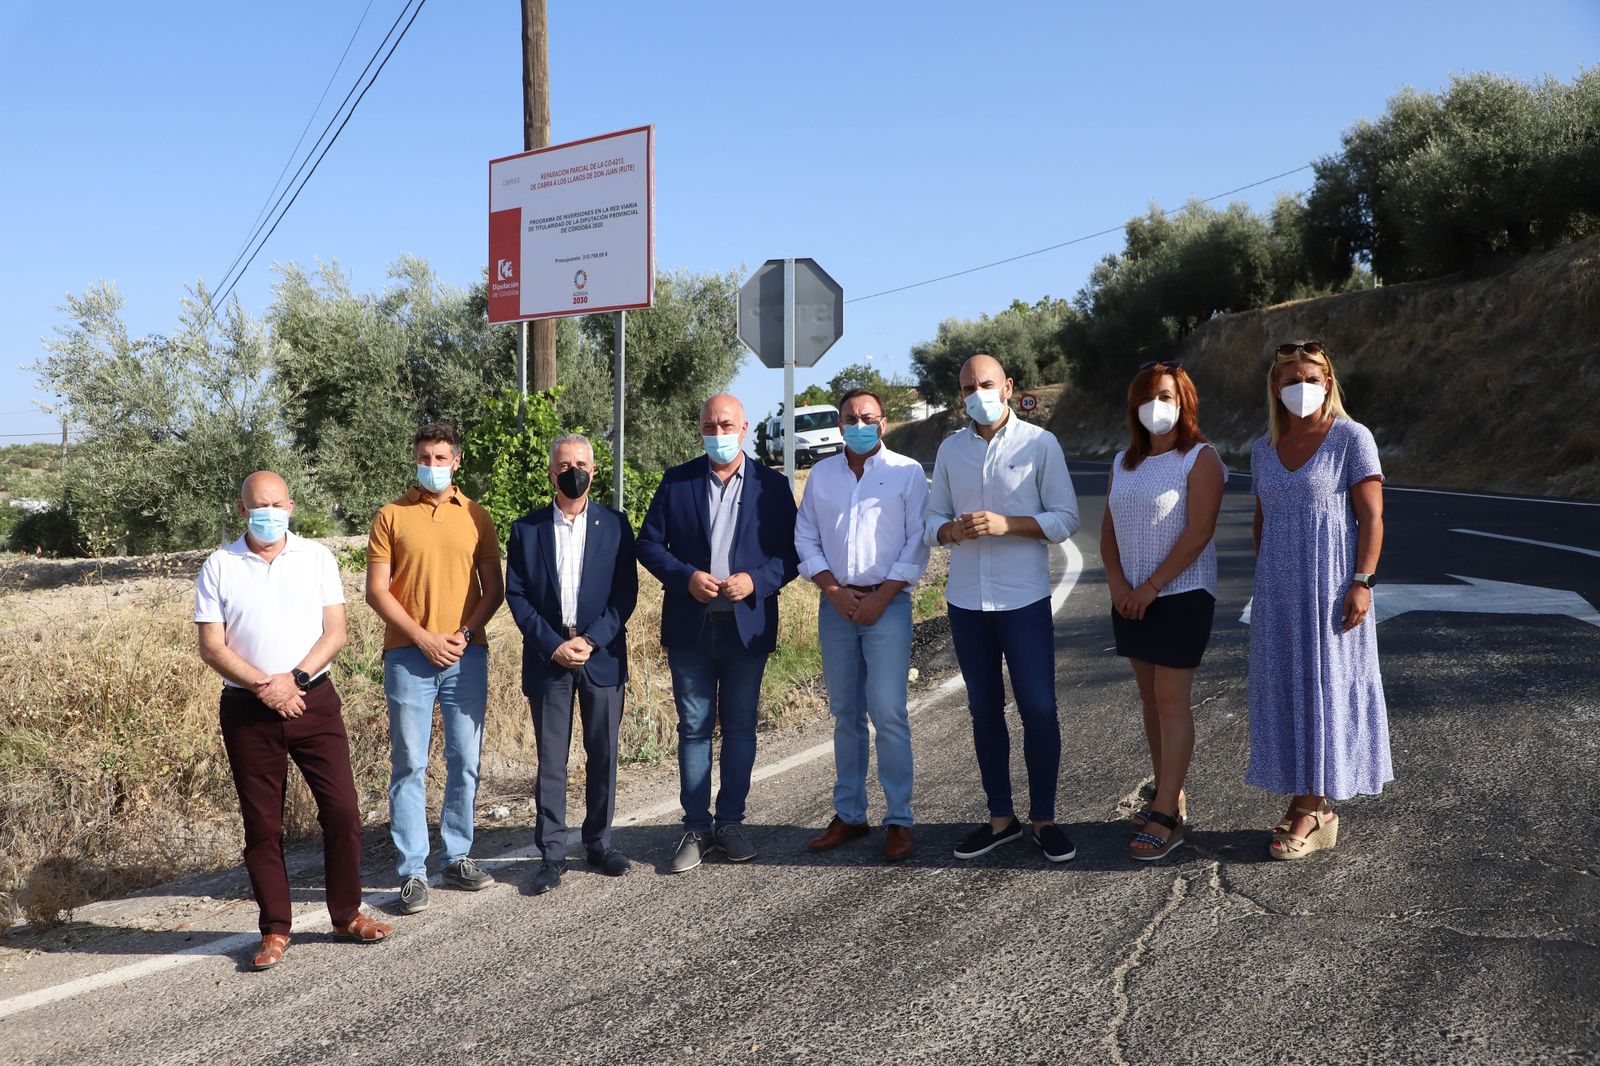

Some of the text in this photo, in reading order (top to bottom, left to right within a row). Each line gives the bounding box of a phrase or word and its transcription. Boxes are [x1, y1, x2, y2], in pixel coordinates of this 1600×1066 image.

[537, 180, 553, 190] CABRA
[558, 178, 567, 186] LOS
[567, 174, 586, 184] LLANOS
[586, 172, 593, 180] DE
[594, 170, 604, 178] DON
[605, 167, 618, 176] JUAN
[618, 164, 635, 175] (RUTE)
[570, 166, 589, 176] PARCIAL
[529, 216, 555, 226] PROGRAMA
[563, 210, 594, 220] INVERSIONES
[620, 202, 638, 210] VIARIA
[535, 221, 564, 231] TITULARIDAD
[609, 209, 639, 219] PROVINCIAL
[572, 296, 588, 304] 2030
